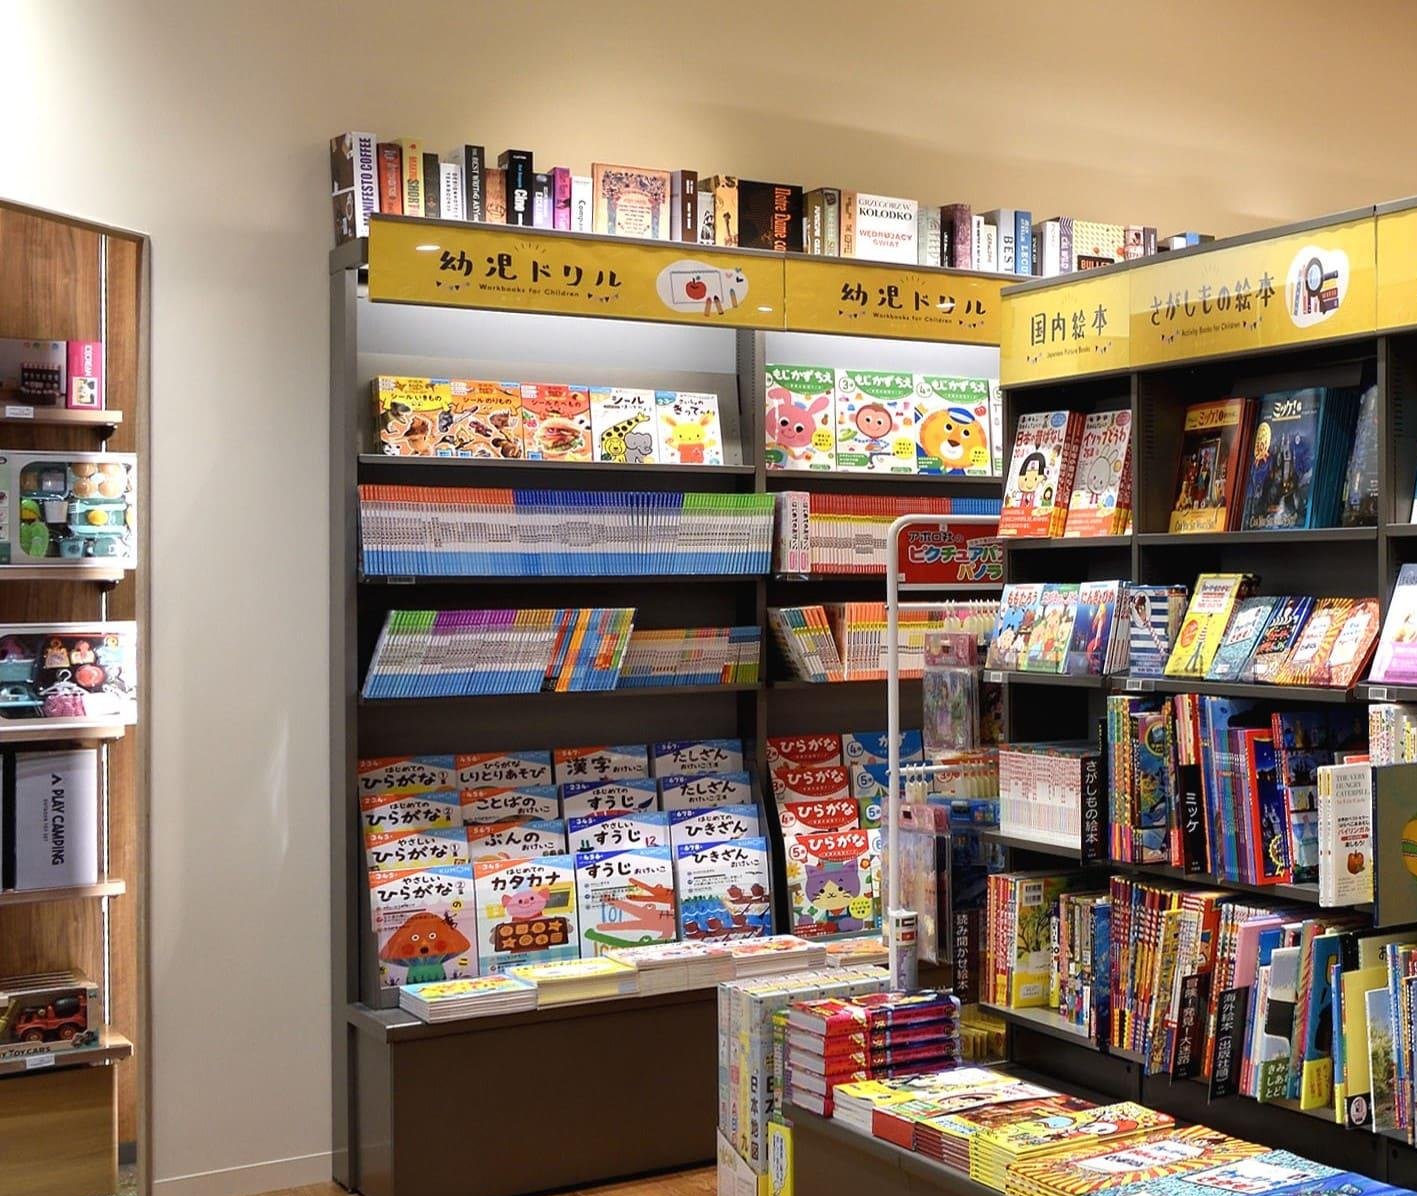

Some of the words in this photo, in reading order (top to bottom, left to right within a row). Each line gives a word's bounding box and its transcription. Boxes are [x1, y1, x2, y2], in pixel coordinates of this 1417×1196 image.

[358, 137, 373, 170] COFFEE
[439, 250, 622, 287] 幼児ドリル
[479, 283, 525, 294] Workbooks
[528, 287, 541, 295] for
[544, 288, 580, 297] Children
[840, 282, 986, 315] 幼児ドリル
[1150, 272, 1275, 327] さがしもの絵本
[1031, 304, 1108, 346] 国内絵本
[779, 736, 839, 753] ひらがな
[672, 745, 729, 765] たしざん
[459, 766, 547, 784] しりとりあそび
[567, 755, 612, 777] 漢字
[361, 771, 437, 791] ひらがな
[786, 768, 845, 785] ひらがな
[680, 780, 737, 797] たしざん
[51, 789, 64, 812] PLAY
[476, 795, 537, 811] ことばの
[587, 793, 634, 810] すうじ
[796, 801, 856, 819] ひらがな
[1085, 760, 1099, 844] さがしもの絵本
[366, 808, 441, 827] ひらがな
[1185, 791, 1200, 833] ミッケ
[593, 828, 641, 845] すうじ
[685, 820, 749, 839] ひきざん
[51, 815, 64, 867] CAMPING
[484, 831, 541, 848] ぶんの
[808, 832, 866, 851] ひらがな
[372, 845, 448, 864] ひらがな
[693, 848, 750, 867] ひきざん
[506, 865, 545, 877] はじめての
[585, 861, 632, 879] すうじ
[402, 874, 441, 886] やさしい
[490, 871, 561, 892] カタカナ
[377, 882, 453, 902] ひらがな
[27, 1045, 51, 1056] CARS
